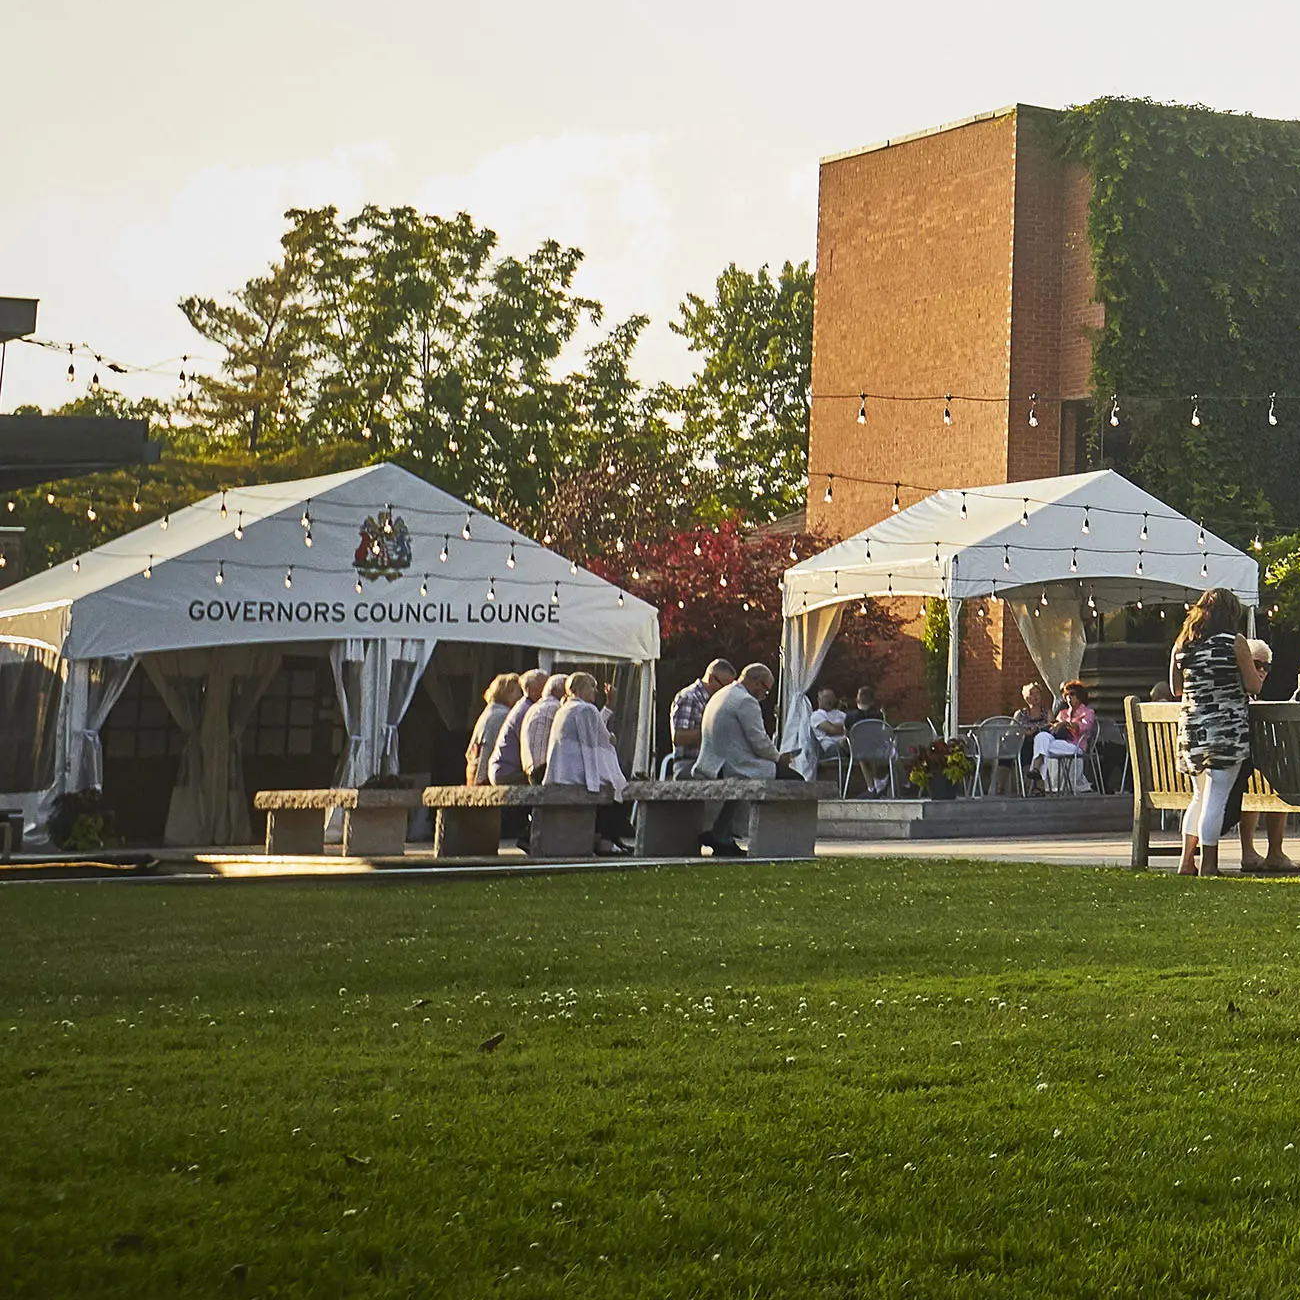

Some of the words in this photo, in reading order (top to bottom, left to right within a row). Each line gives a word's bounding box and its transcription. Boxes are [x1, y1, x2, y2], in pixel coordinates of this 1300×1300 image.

[188, 599, 346, 623] GOVERNORS
[353, 601, 460, 624] COUNCIL
[466, 602, 561, 624] LOUNGE
